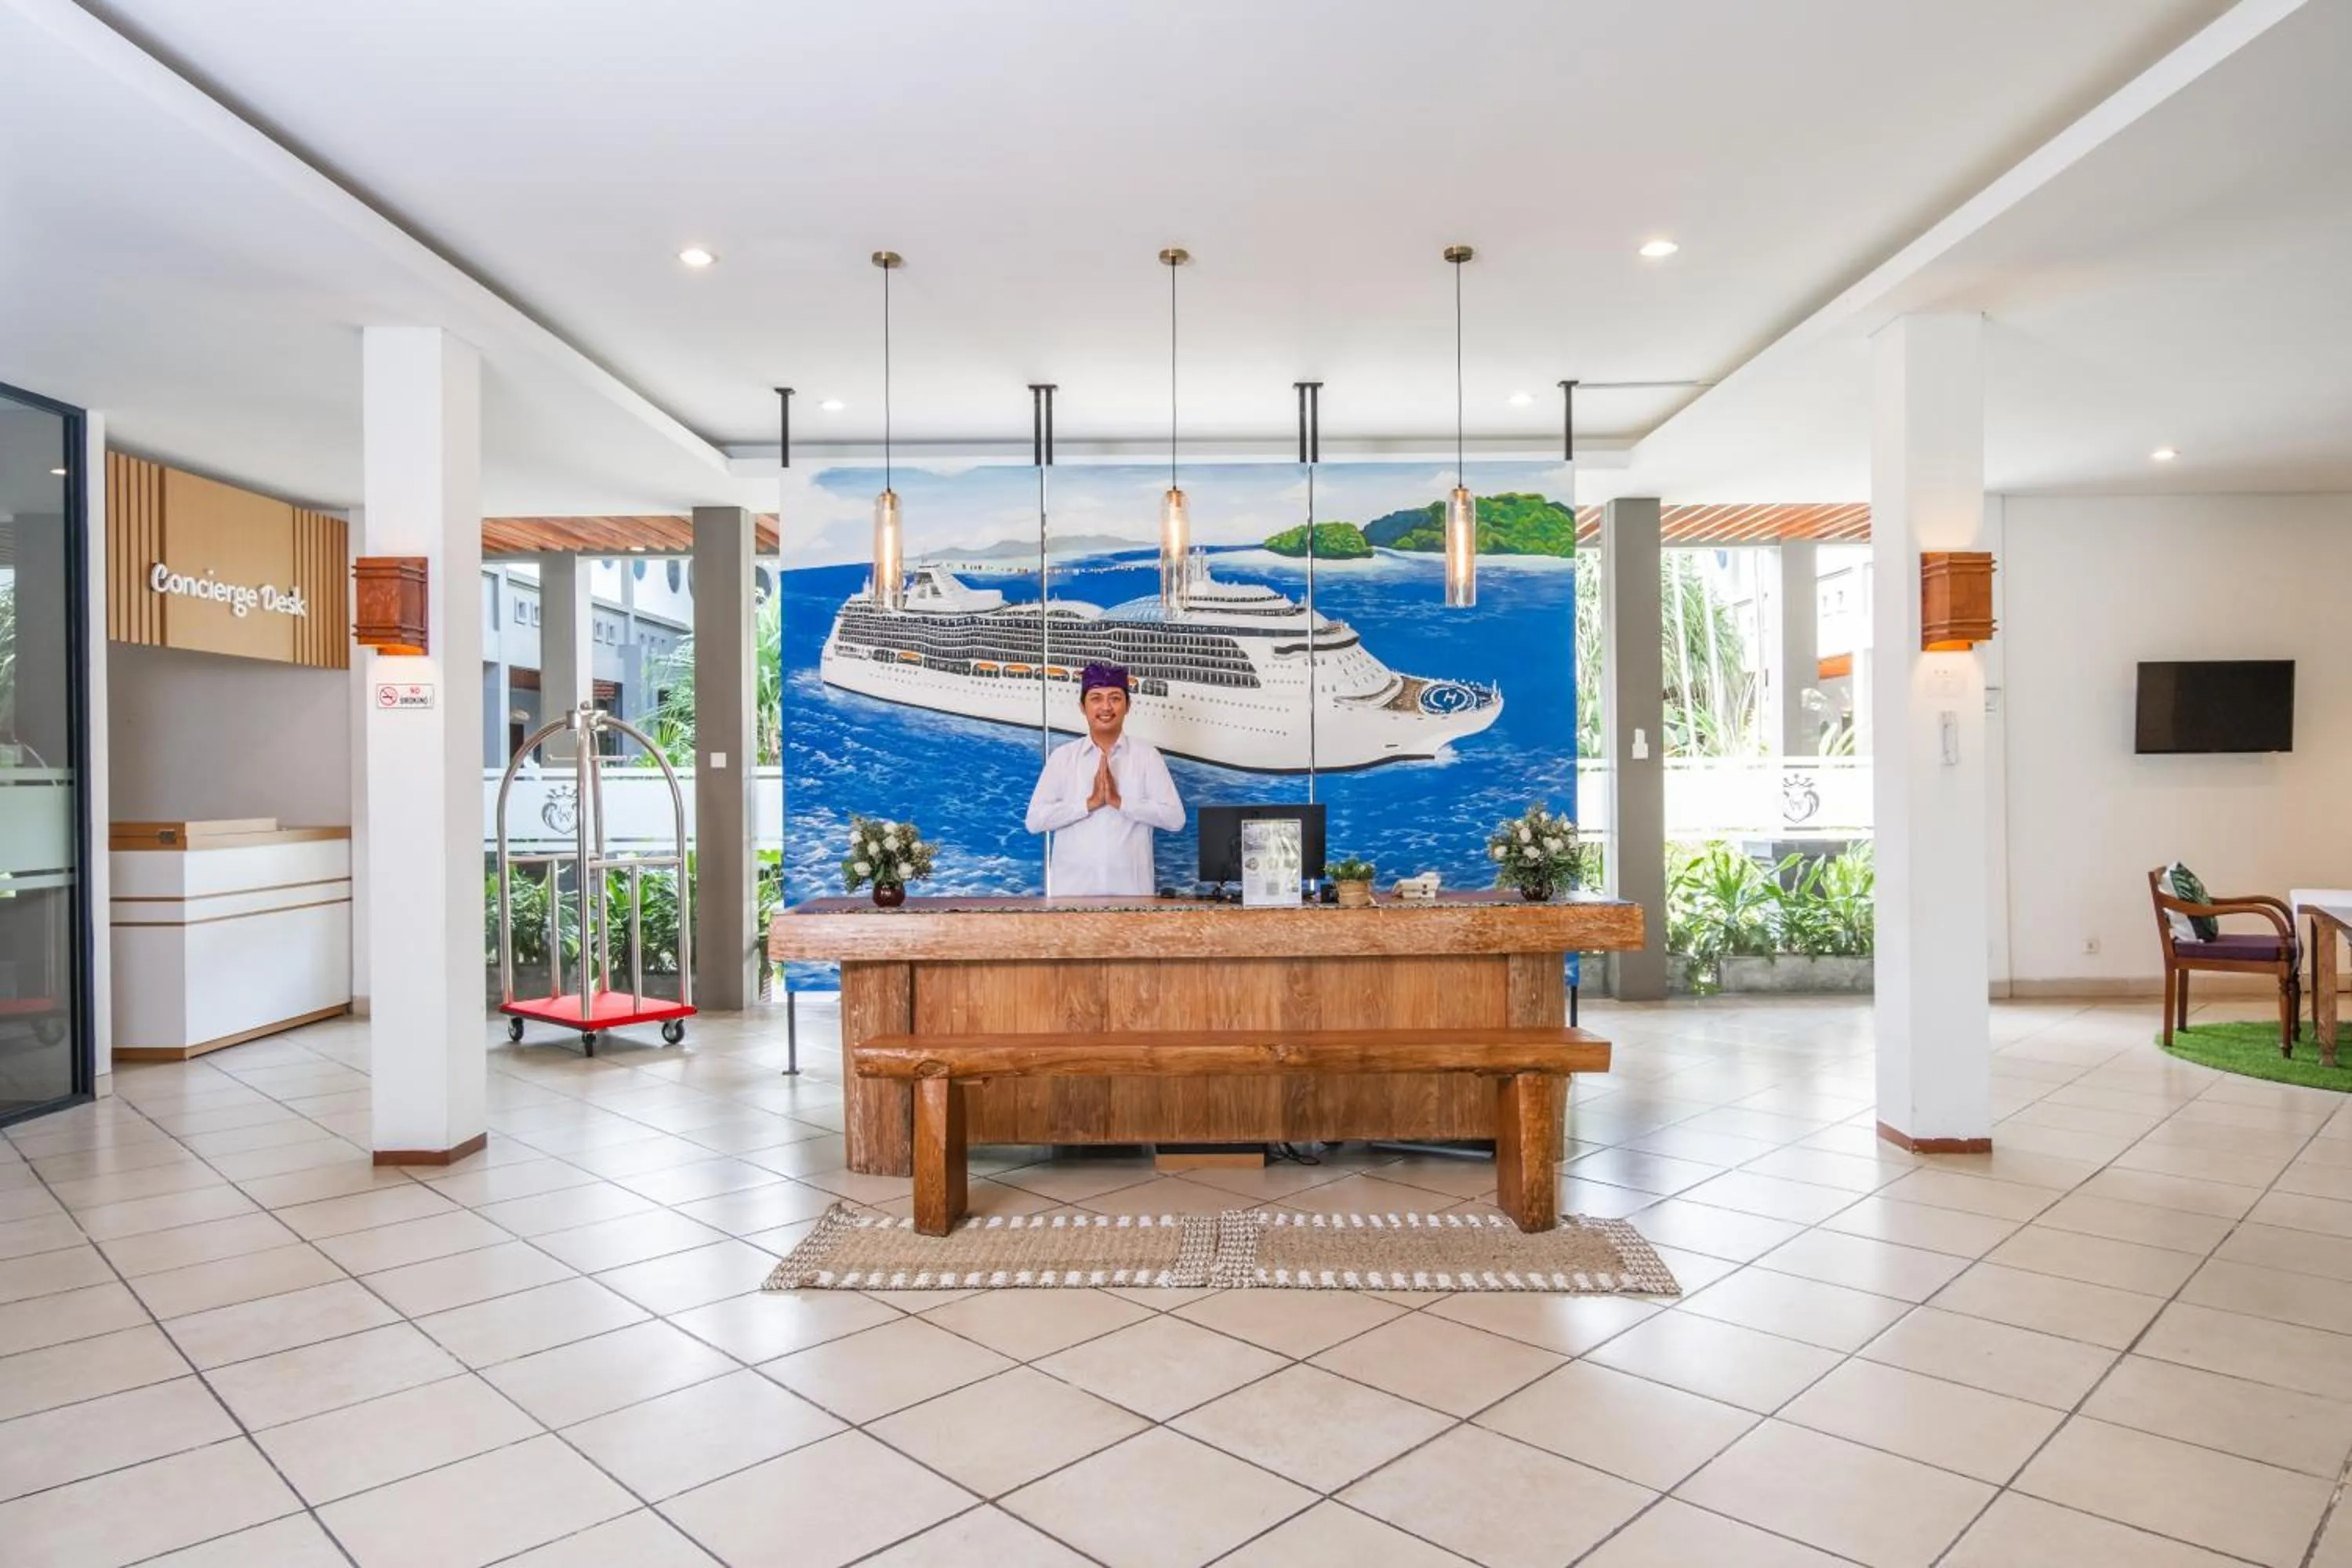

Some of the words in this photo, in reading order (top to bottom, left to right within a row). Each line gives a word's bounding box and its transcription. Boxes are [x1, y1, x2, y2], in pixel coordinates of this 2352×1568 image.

[150, 563, 257, 617] Concierge
[260, 584, 307, 617] Desk
[1443, 691, 1457, 704] H
